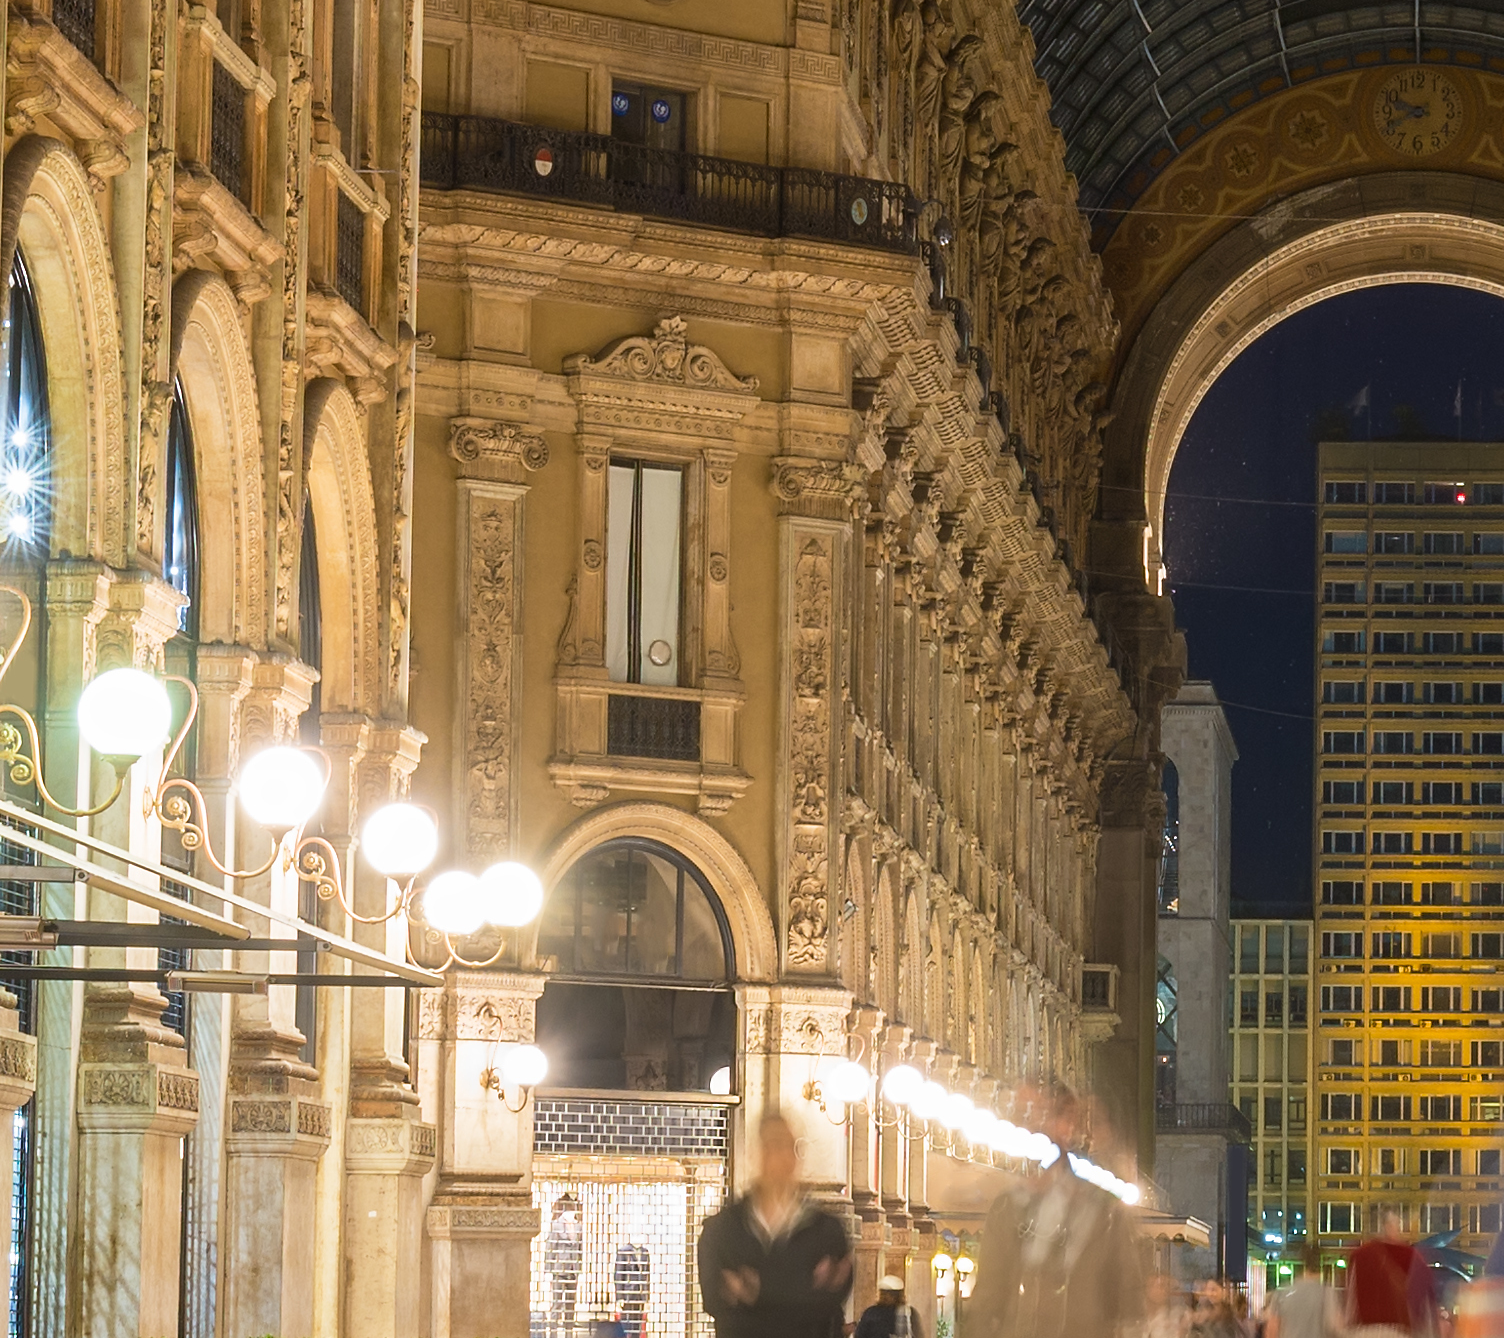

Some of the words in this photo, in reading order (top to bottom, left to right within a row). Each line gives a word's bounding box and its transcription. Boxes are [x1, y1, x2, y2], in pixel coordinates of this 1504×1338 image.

[1399, 78, 1408, 93] 11
[1410, 74, 1426, 89] 12
[1431, 77, 1437, 92] 1
[1385, 89, 1399, 103] 10
[1441, 87, 1452, 102] 2
[1382, 105, 1392, 120] 9
[1445, 102, 1455, 120] 3
[1440, 122, 1450, 137] 4
[1397, 132, 1407, 148] 7
[1412, 135, 1423, 151] 6
[1431, 132, 1441, 149] 5
